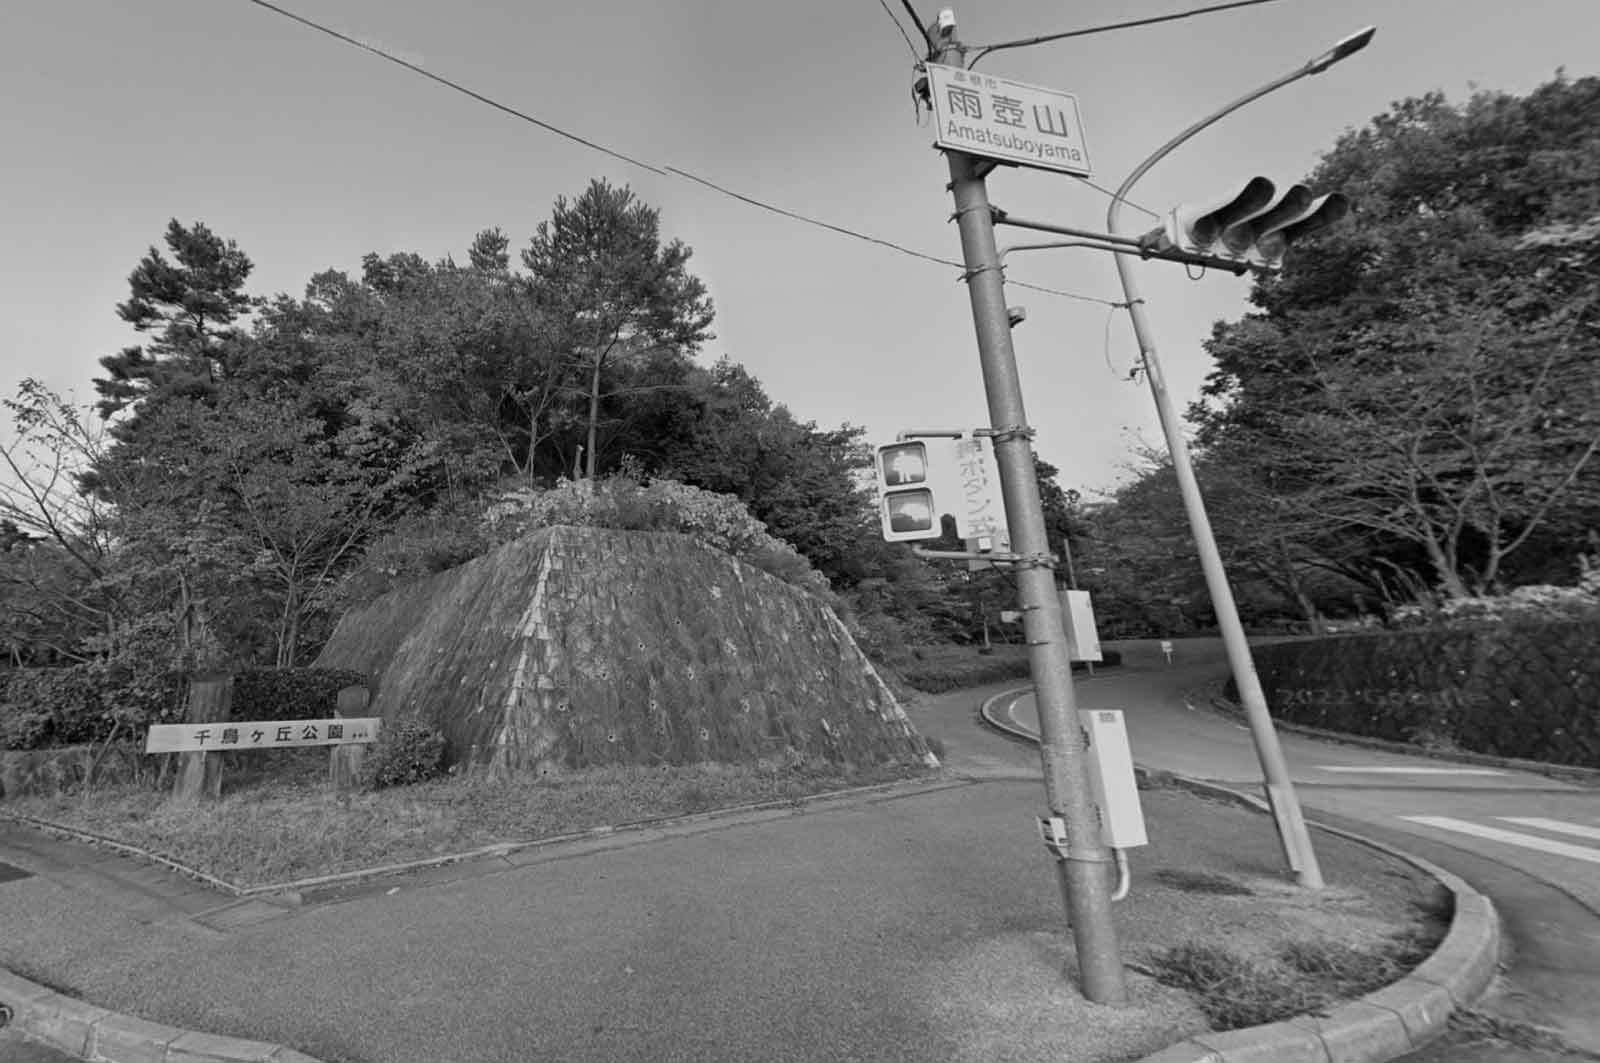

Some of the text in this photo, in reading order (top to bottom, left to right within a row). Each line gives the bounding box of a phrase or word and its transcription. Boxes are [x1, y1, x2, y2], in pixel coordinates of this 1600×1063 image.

[946, 84, 1068, 138] 雨壺山
[948, 120, 1081, 161] Amatsuboyama
